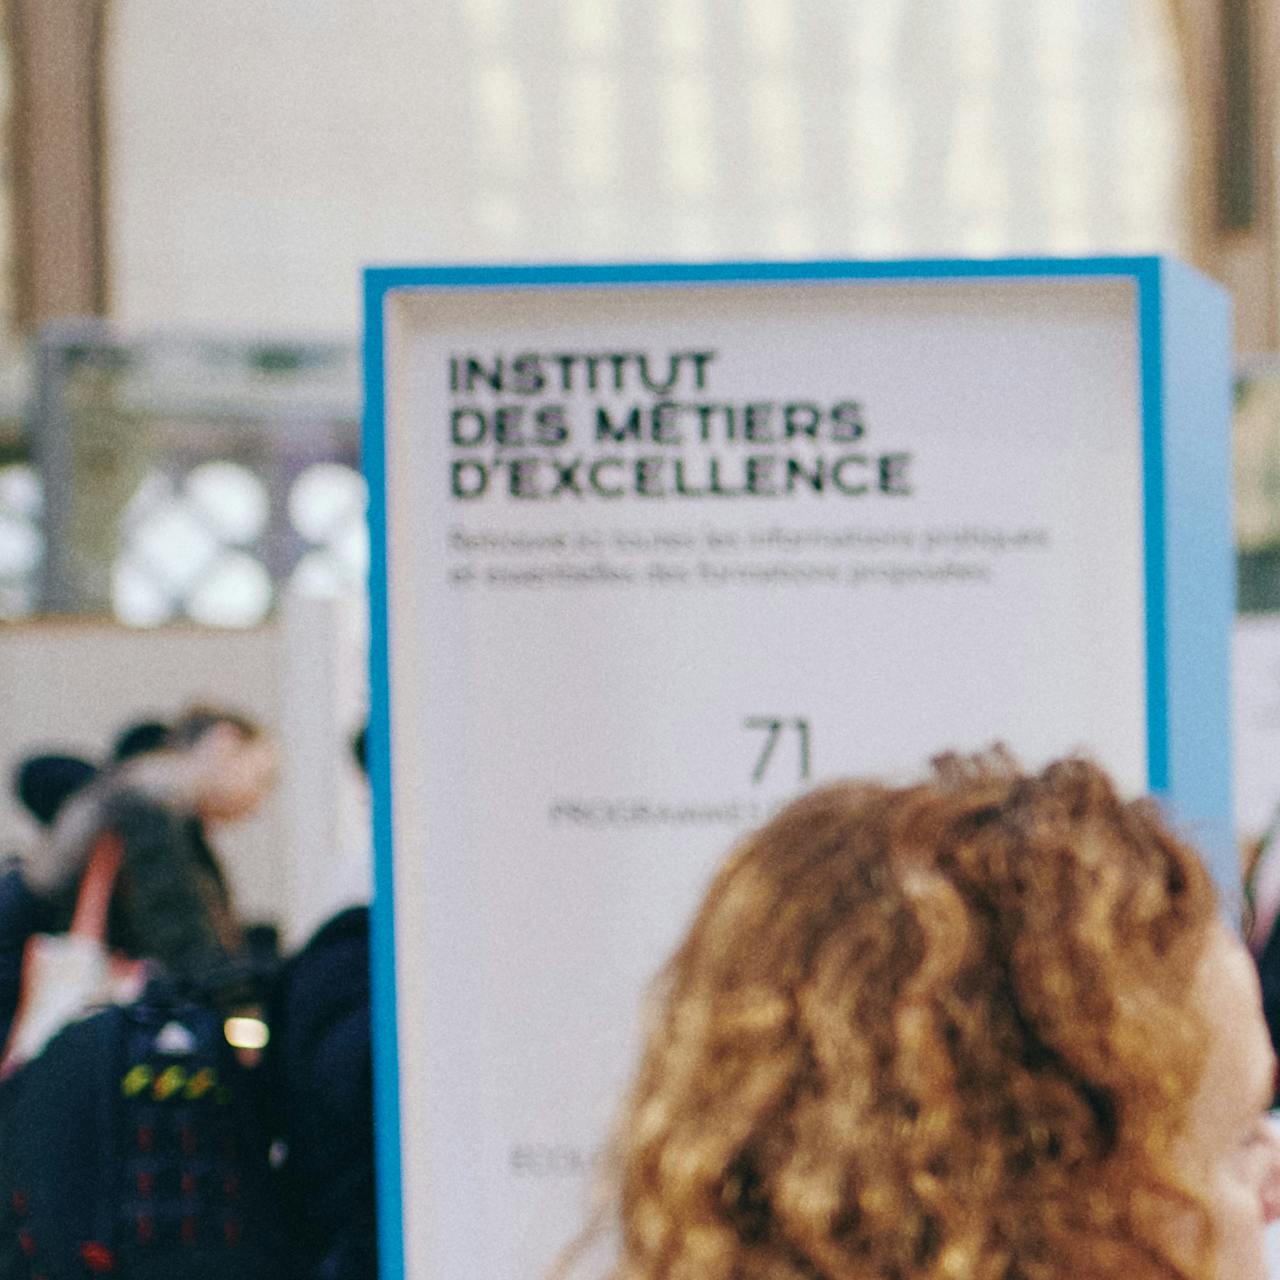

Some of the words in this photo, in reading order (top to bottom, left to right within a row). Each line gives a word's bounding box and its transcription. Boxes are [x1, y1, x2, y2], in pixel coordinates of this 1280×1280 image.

[447, 350, 717, 397] INSTITUT
[448, 403, 571, 450] DES
[595, 393, 868, 445] MÉTIERS
[448, 451, 914, 502] D'EXCELLENCE
[743, 715, 813, 786] 71
